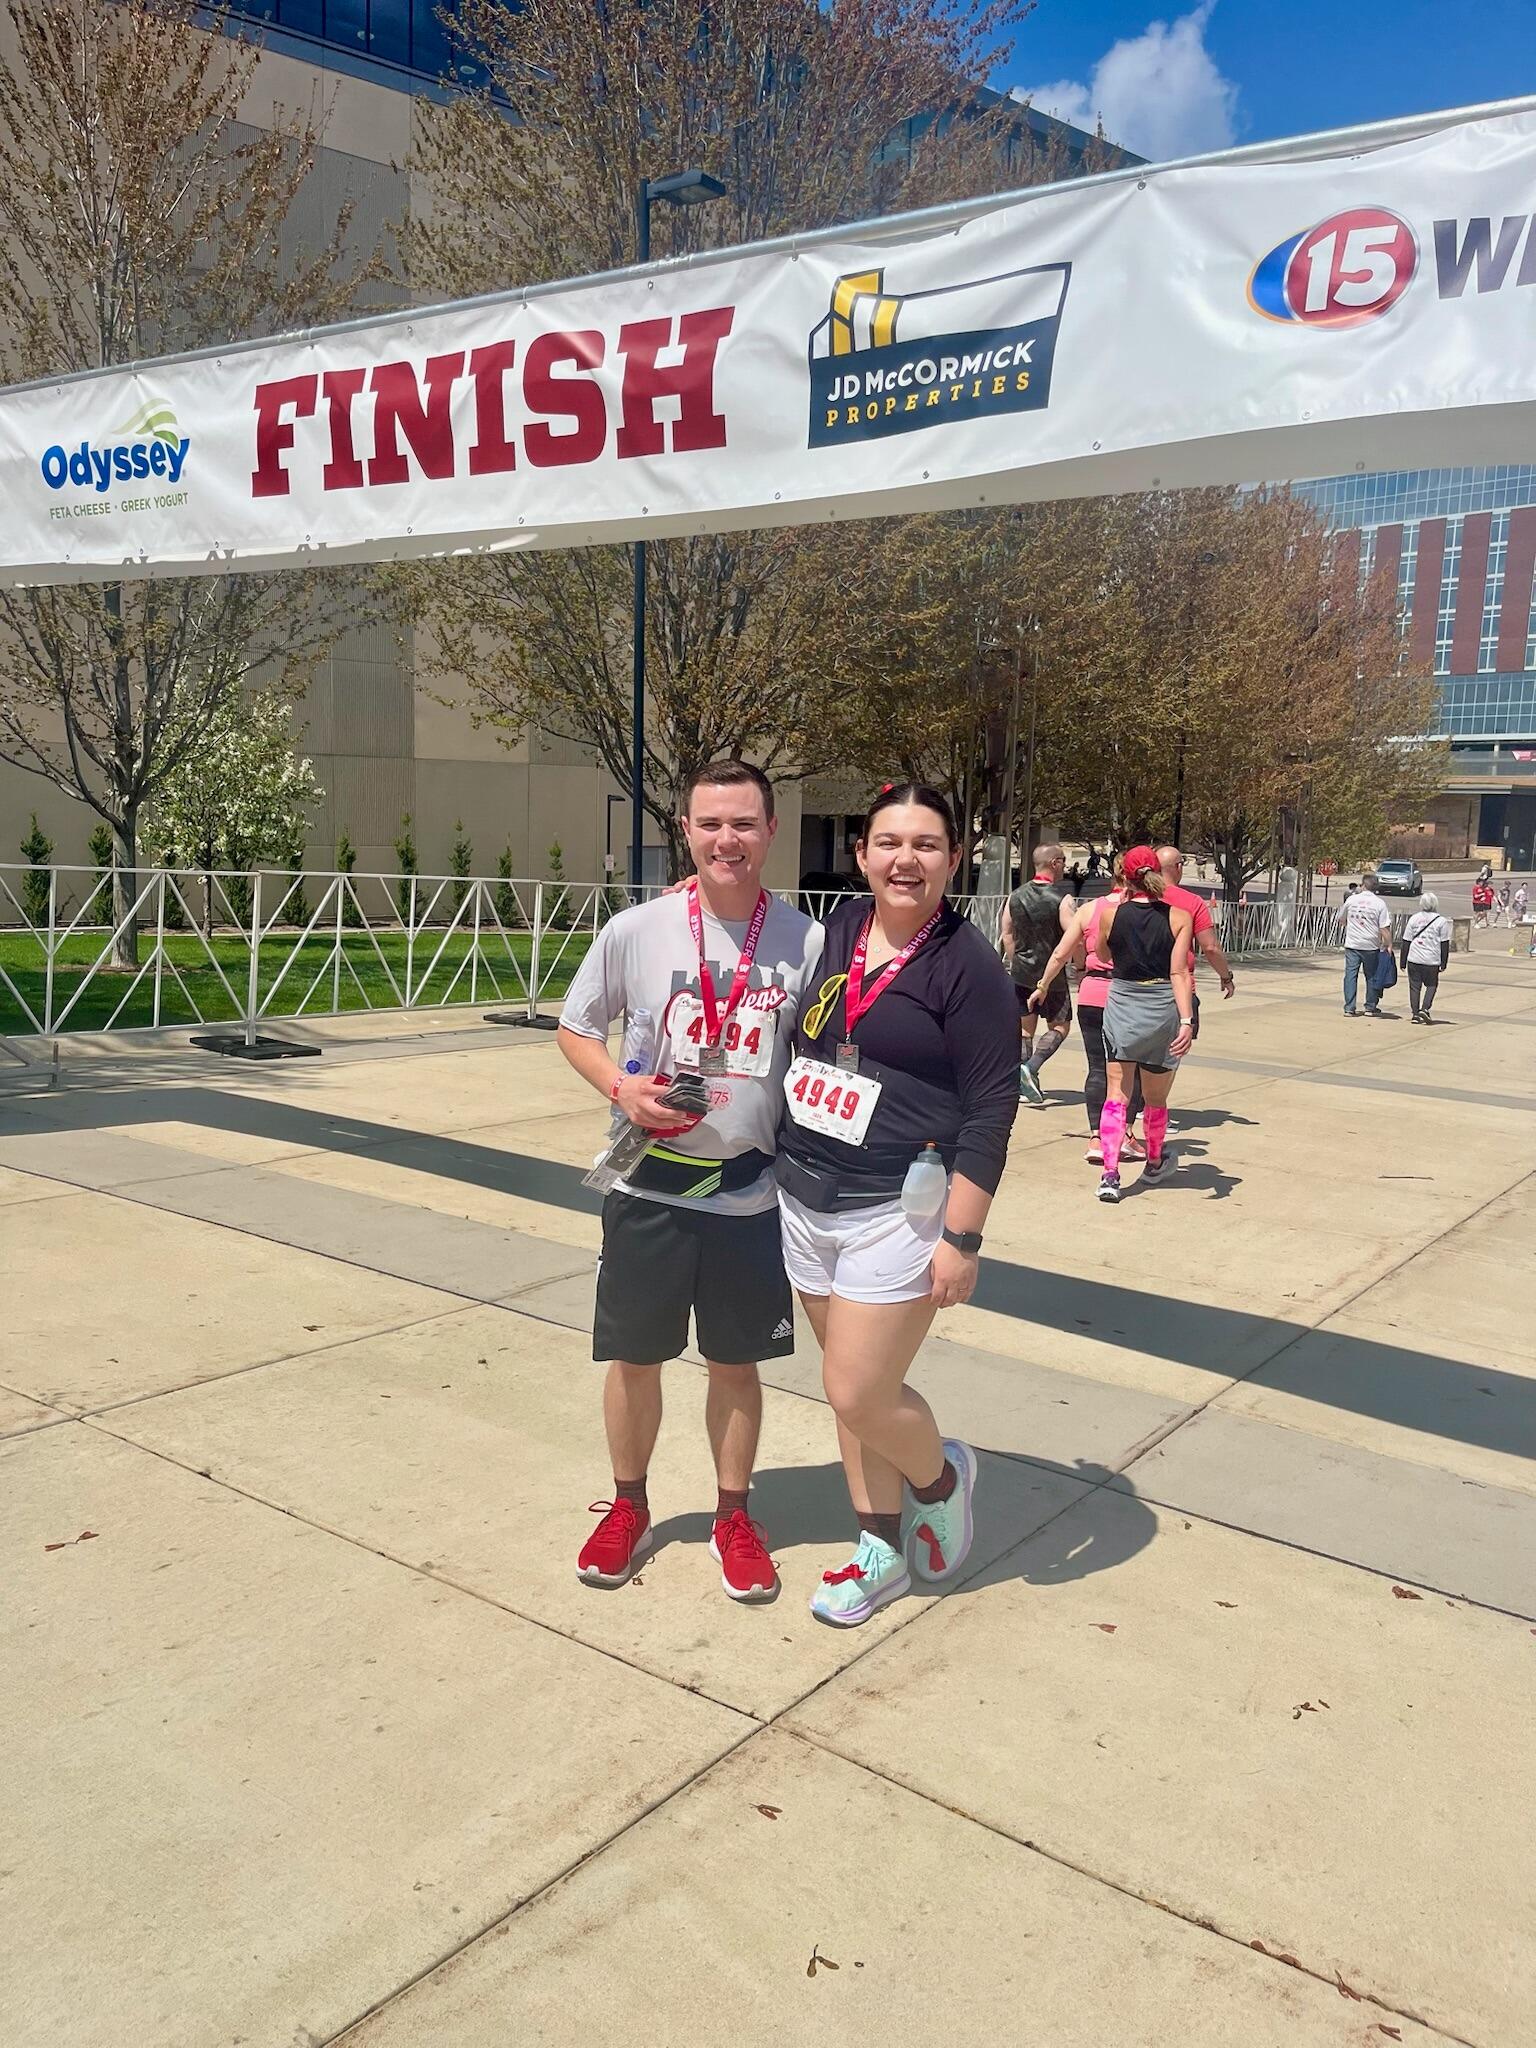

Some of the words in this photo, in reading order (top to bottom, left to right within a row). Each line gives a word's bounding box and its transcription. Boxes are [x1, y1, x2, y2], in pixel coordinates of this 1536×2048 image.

[1305, 225, 1399, 312] 15
[827, 375, 861, 402] JD
[865, 339, 1036, 396] McCORMICK
[252, 306, 736, 498] FINISH
[826, 372, 1030, 427] PROPERTIES
[41, 439, 190, 492] Odyssey
[50, 507, 72, 520] FETA
[73, 502, 111, 518] CHEESE
[121, 498, 151, 512] GREEK
[154, 492, 189, 508] YOGURT
[743, 902, 766, 958] FINISHER
[793, 1074, 860, 1120] 4949
